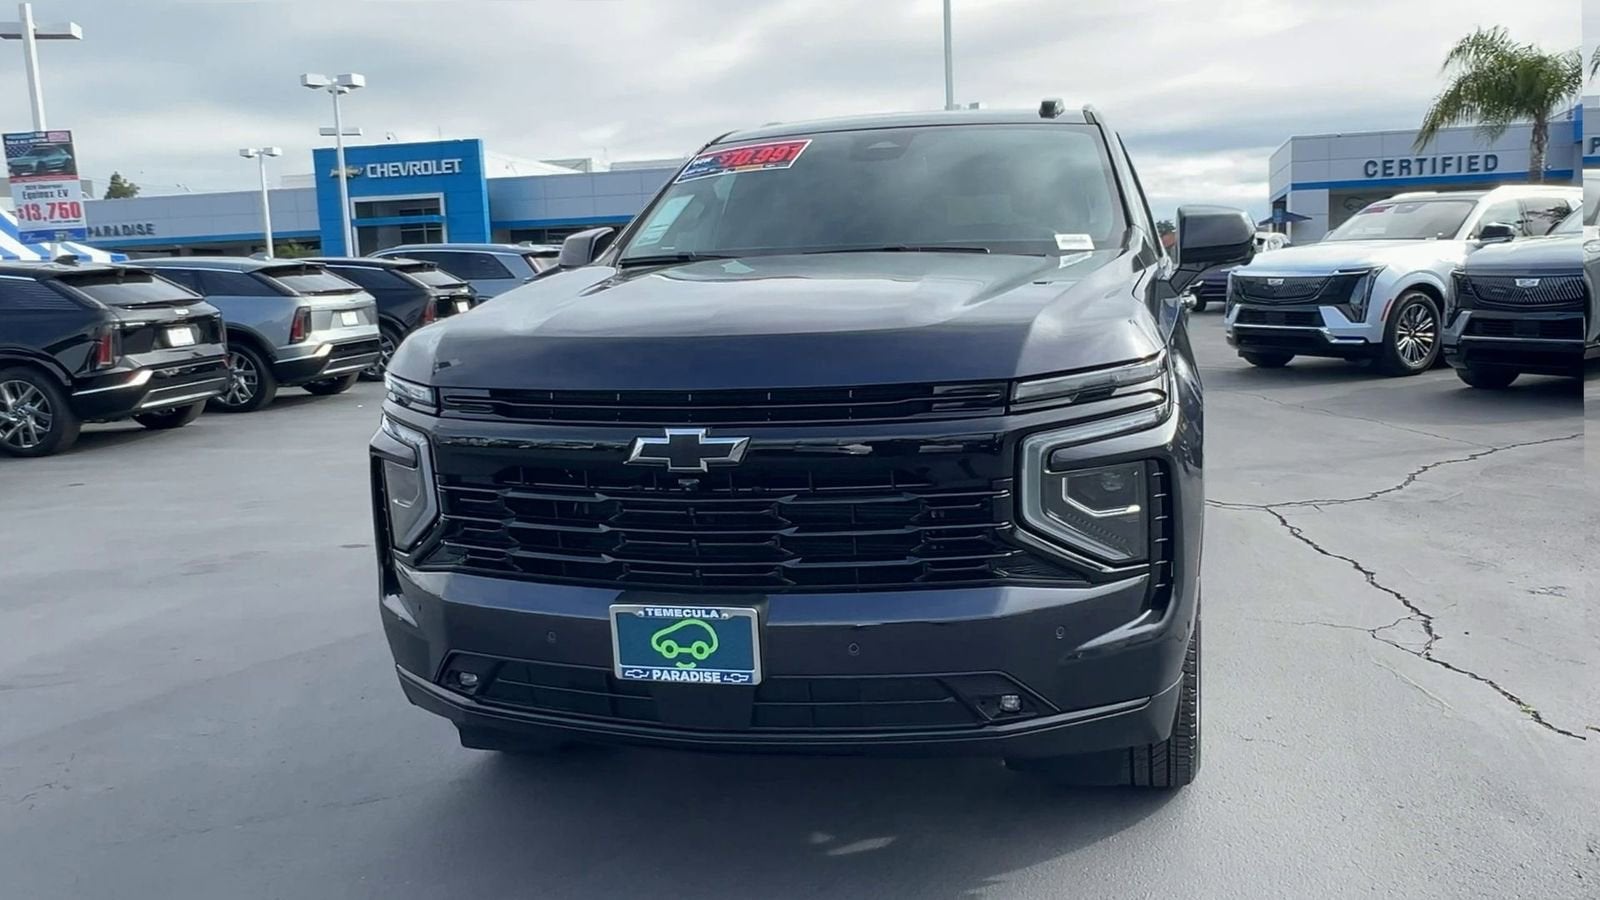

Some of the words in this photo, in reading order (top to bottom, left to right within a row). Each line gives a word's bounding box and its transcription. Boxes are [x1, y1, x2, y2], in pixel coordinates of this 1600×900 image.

[367, 159, 462, 178] CHEVROLET
[1364, 155, 1498, 177] CERTIFIED
[58, 189, 69, 198] EV
[87, 224, 154, 237] PARADISE
[645, 608, 720, 618] TEMECULA
[652, 669, 721, 683] PARADISE
